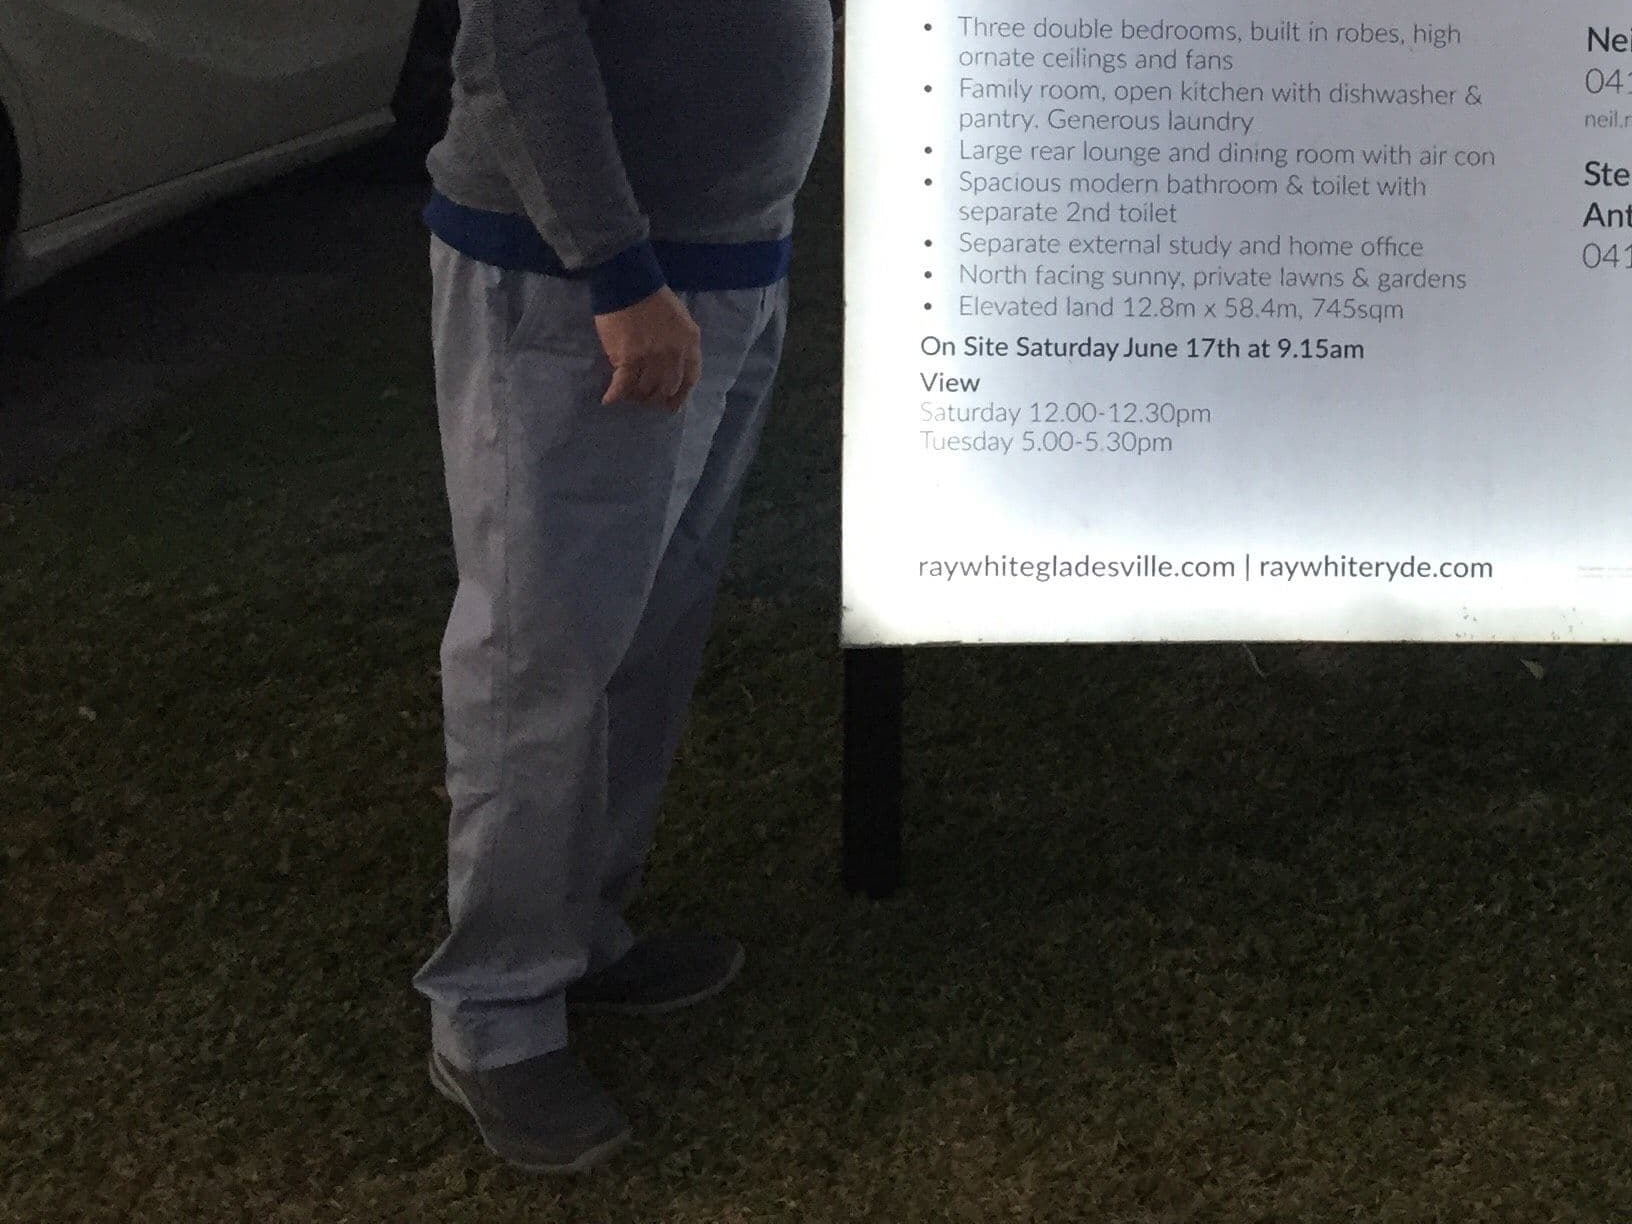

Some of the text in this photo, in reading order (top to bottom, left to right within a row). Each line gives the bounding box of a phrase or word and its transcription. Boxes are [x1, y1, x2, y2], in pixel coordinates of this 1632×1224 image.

[956, 14, 1462, 50] Three double bedrooms, built in robes, high
[956, 46, 1234, 75] ornate ceilings and fans
[958, 76, 1483, 107] Family room, open kitchen with dishwasher &
[958, 107, 1255, 137] pantry. Generous laundry
[959, 138, 1496, 170] Large rear lounge and dining room with air con
[958, 169, 1427, 198] Spacious modern bathroom & toilet with
[957, 200, 1178, 227] separate 2nd toilet
[957, 231, 1424, 260] Separate external study and home office
[958, 262, 1468, 295] North facing sunny, private lawns & gardens
[958, 294, 1405, 325] Elevated land 12.8m x 58.4m, 745sqm
[919, 334, 1365, 365] On Site Saturday June 17th at 9.15am
[918, 370, 982, 394] View
[919, 400, 1212, 429] Saturday 12.00-12.30pm
[919, 429, 1174, 457] Tuesday 5.00-5.30pm
[918, 553, 1236, 584] raywhitegladesville.com
[1259, 553, 1494, 584] raywhiteryde.com
